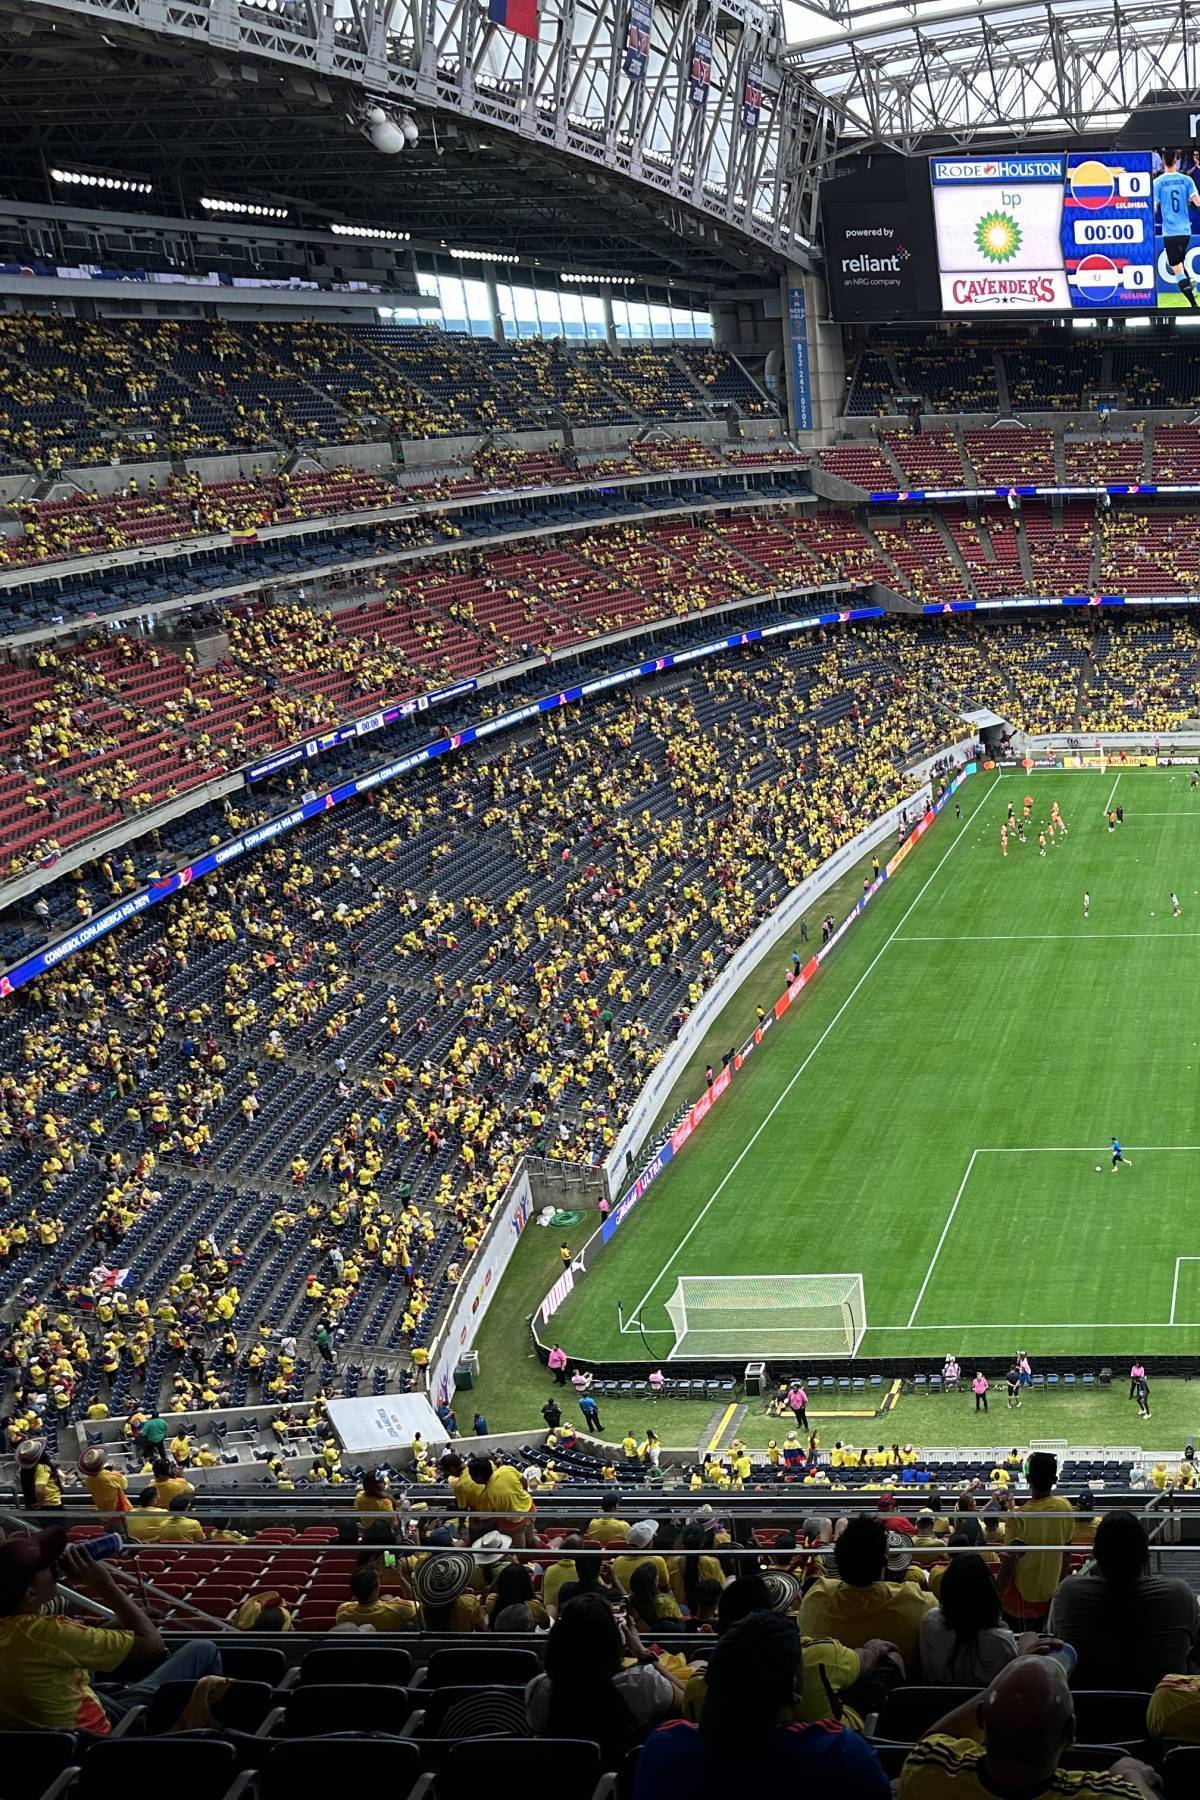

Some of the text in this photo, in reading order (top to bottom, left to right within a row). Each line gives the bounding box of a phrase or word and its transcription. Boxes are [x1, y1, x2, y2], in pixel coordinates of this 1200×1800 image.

[1129, 178, 1140, 193] 0
[1001, 191, 1021, 209] bp
[1115, 201, 1148, 209] COLOMBIA
[1170, 190, 1180, 213] 6
[846, 227, 894, 238] powered by
[1085, 223, 1134, 241] 00:00
[842, 254, 900, 273] reliant
[853, 278, 868, 286] NRG
[869, 278, 901, 287] company
[1133, 271, 1143, 285] 0
[952, 277, 1055, 304] CAVENDER'S
[44, 894, 150, 964] CONMEBOL COPA AMERICA USA 2024
[641, 1157, 663, 1190] ULTRA
[542, 1267, 574, 1325] PUMA
